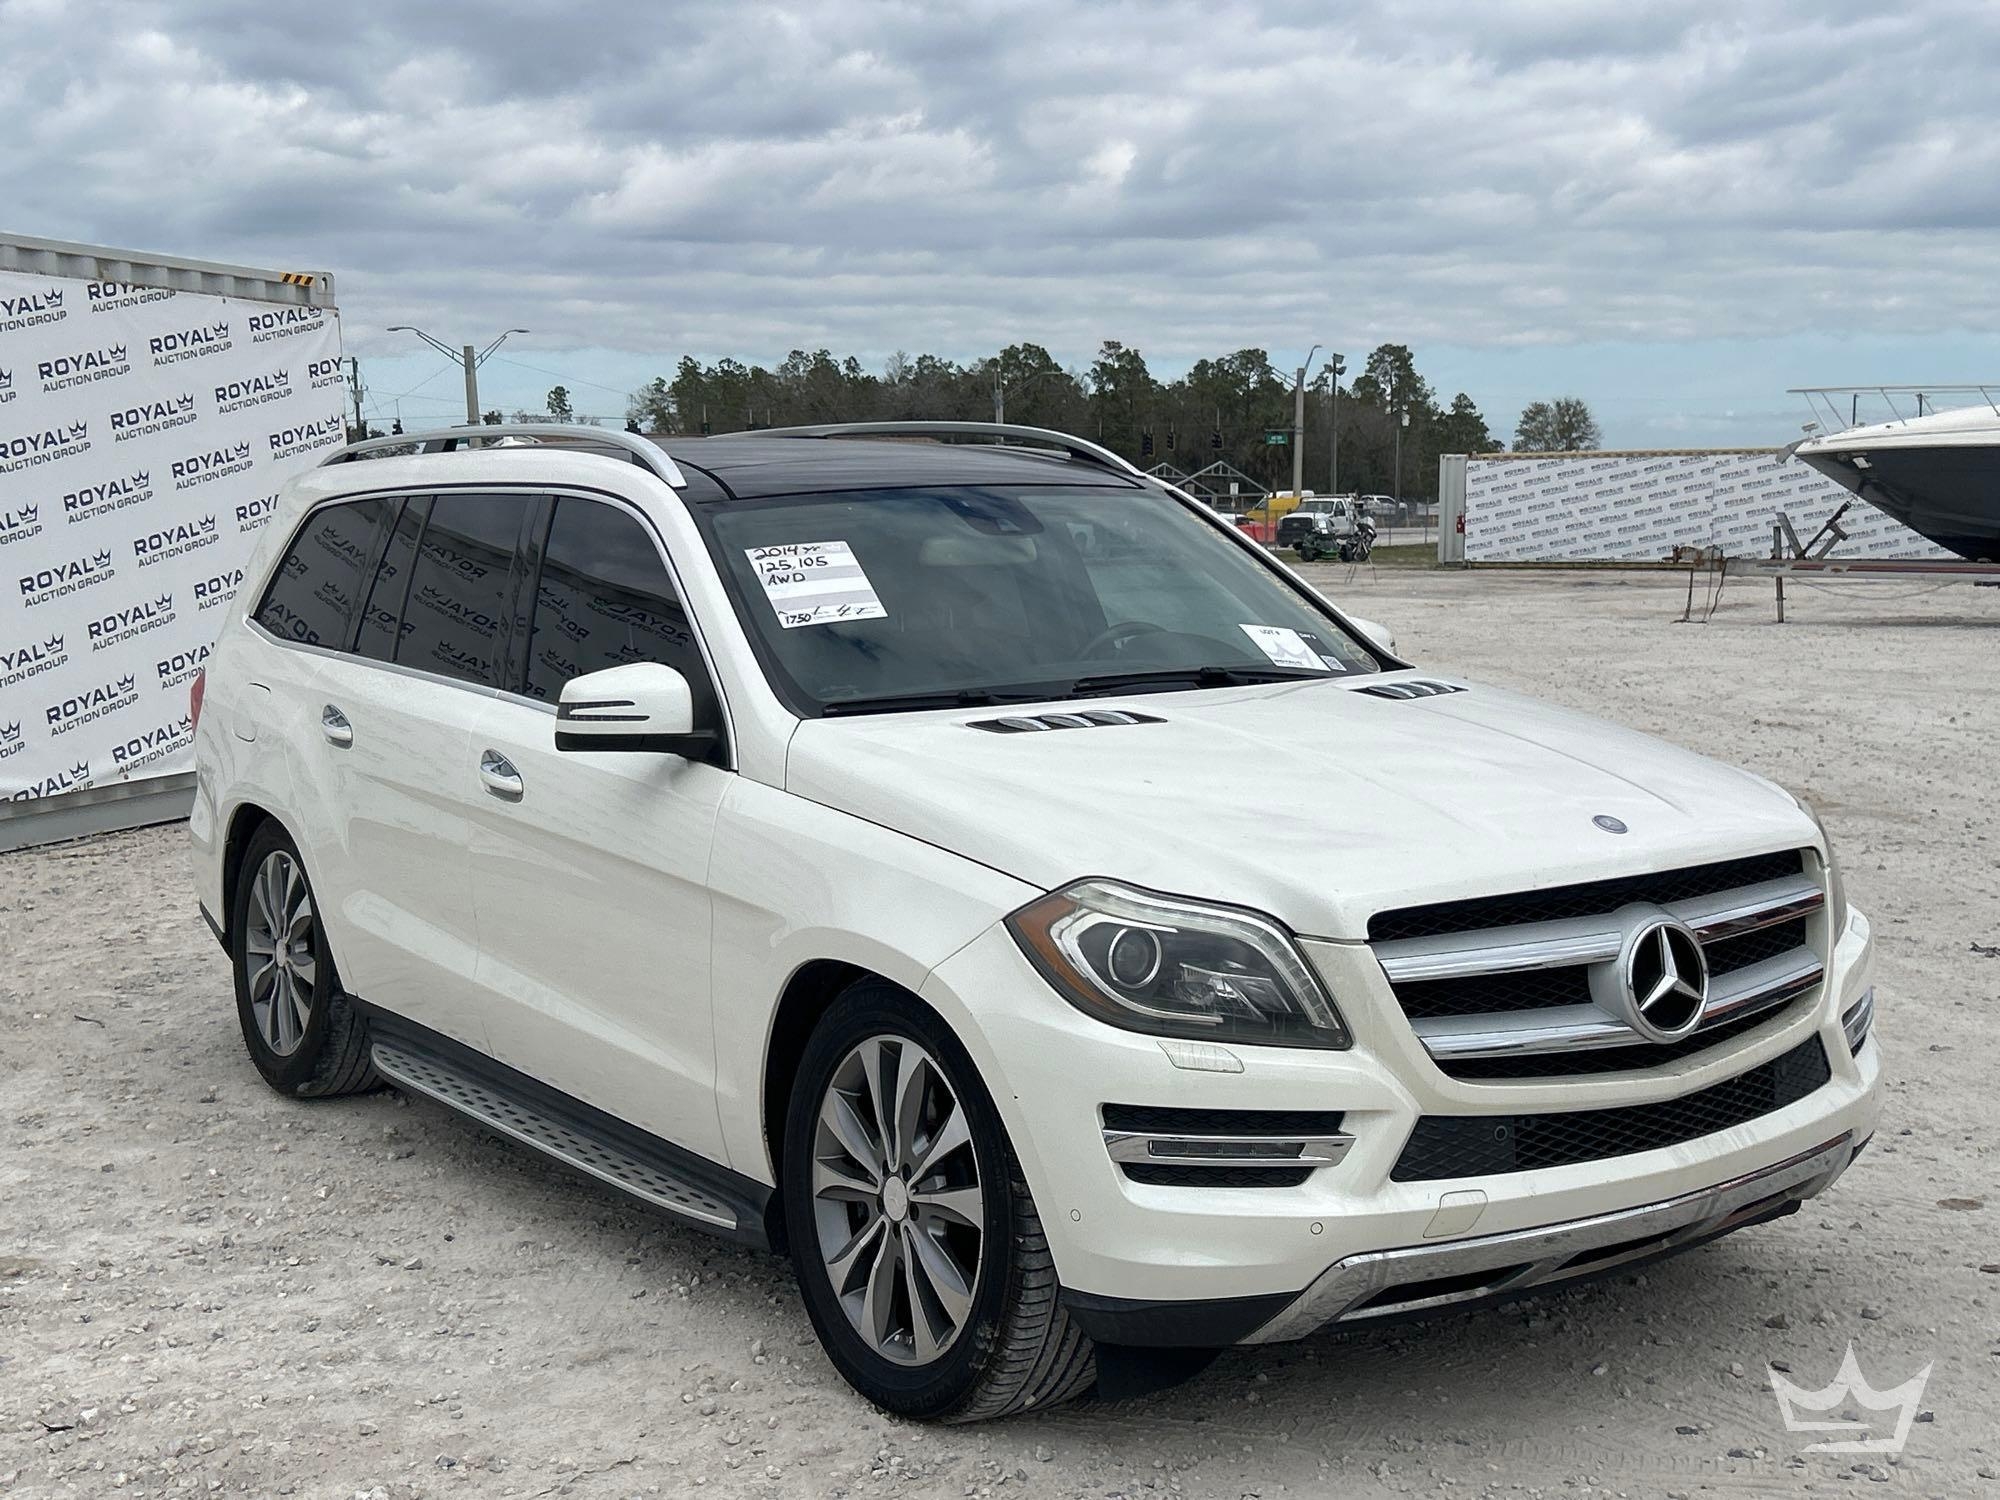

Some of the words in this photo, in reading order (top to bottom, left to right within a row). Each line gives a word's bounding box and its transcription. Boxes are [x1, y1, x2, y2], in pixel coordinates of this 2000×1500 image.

[0, 295, 45, 316] YAL
[88, 282, 153, 300] ROY
[92, 296, 138, 313] AUCTION
[140, 290, 176, 305] GROUP
[0, 318, 26, 332] TION
[27, 310, 67, 327] GROUP
[248, 308, 308, 332] ROYAL
[252, 326, 293, 343] AUCTION
[294, 320, 324, 335] GROUP
[150, 327, 214, 354] ROYAL
[153, 350, 198, 367] AUCTION
[199, 341, 232, 357] GROUP
[38, 350, 110, 380] ROYAL
[43, 373, 92, 393] AUCTION
[94, 364, 131, 381] GROUP
[308, 357, 342, 378] ROY
[215, 375, 275, 402] ROYAL
[311, 375, 343, 389] AUCTIO
[110, 400, 178, 430] ROYAL
[218, 397, 260, 415] AUCTION
[261, 388, 292, 404] GROUP
[115, 423, 161, 443] AUCTION
[162, 413, 197, 430] GROUP
[269, 421, 327, 449] ROYAL
[0, 429, 70, 459] ROYAL
[0, 452, 51, 474] AUCTION
[53, 441, 91, 460] GROUP
[273, 443, 312, 461] AUCTION
[313, 433, 343, 449] GROUP
[171, 449, 236, 478] ROYAL
[175, 473, 220, 491] AUCTION
[220, 460, 253, 477] GROUP
[63, 478, 133, 512] ROYAL
[68, 502, 116, 525] AUCTION
[117, 490, 153, 508] GROUP
[0, 524, 43, 545] GROUP
[133, 522, 201, 556] ROYAL
[138, 545, 183, 568] AUCTION
[184, 533, 219, 552] GROUP
[753, 545, 798, 560] 2014
[19, 558, 94, 595] ROYAL
[24, 582, 76, 608] AUCTION
[77, 569, 115, 589] GROUP
[193, 566, 246, 600] ROYA
[767, 572, 806, 586] AWD
[87, 603, 157, 640] ROYAL
[92, 627, 139, 652] AUCTION
[140, 612, 176, 633] GROUP
[784, 613, 812, 624] 1750
[0, 644, 46, 671] YAL
[27, 654, 69, 676] GROUP
[157, 642, 215, 678] ROYA
[46, 684, 118, 724] ROYAL
[51, 709, 101, 737] AUCTION
[101, 693, 139, 715] GROUP
[0, 741, 25, 758] OUP
[112, 723, 180, 764] ROYAL
[118, 747, 165, 775] AUCTION
[165, 734, 194, 754] GROU
[0, 772, 72, 802] OYAL
